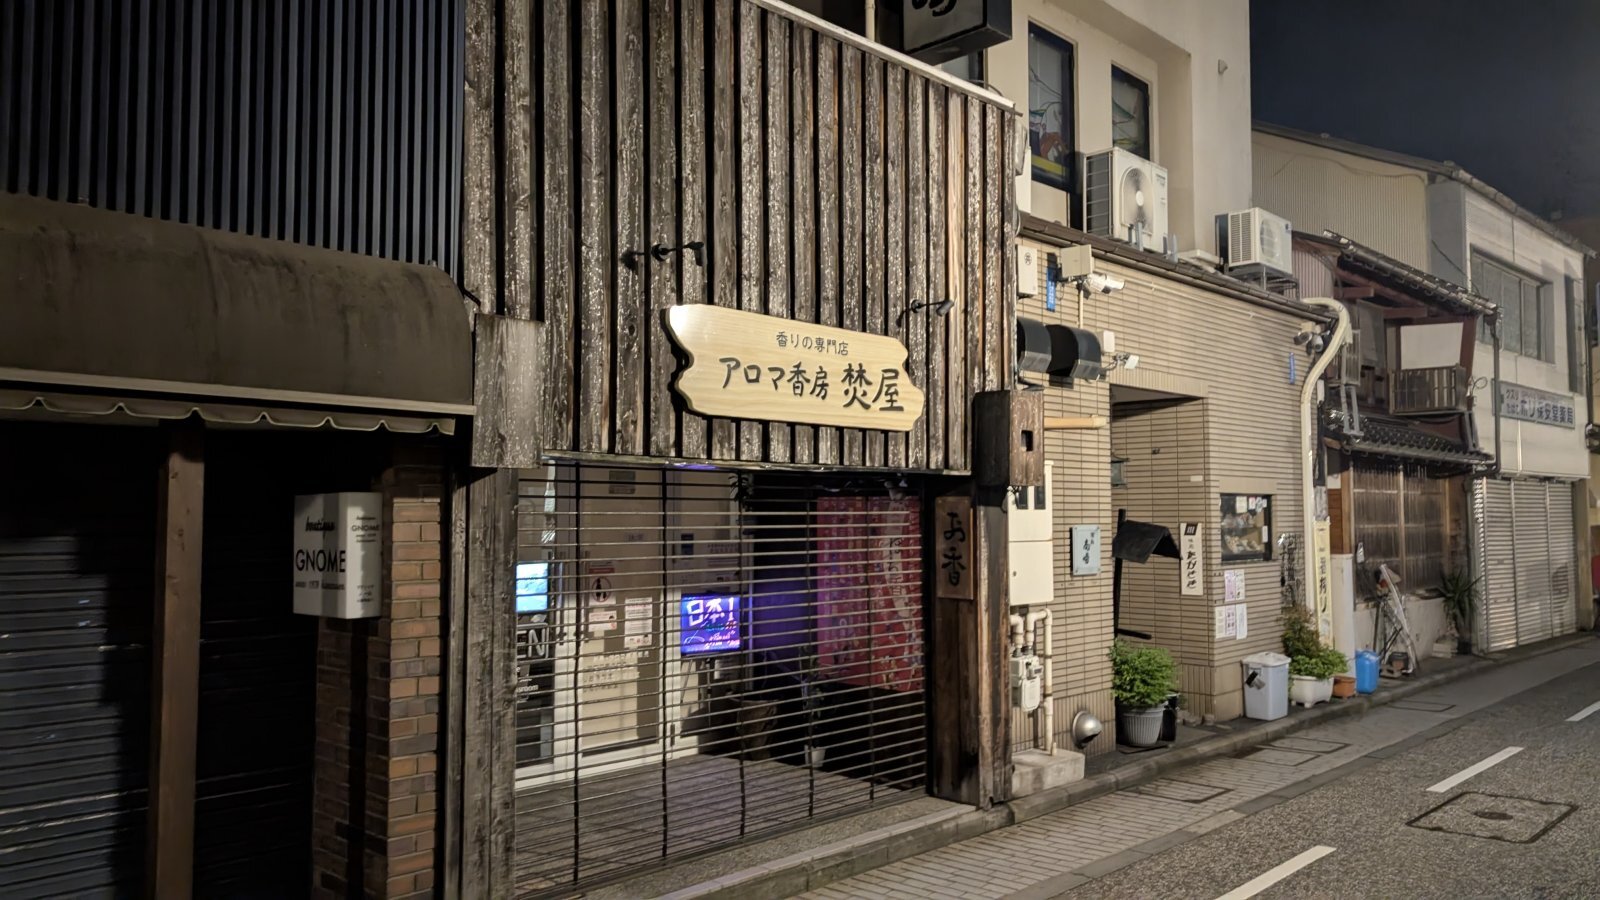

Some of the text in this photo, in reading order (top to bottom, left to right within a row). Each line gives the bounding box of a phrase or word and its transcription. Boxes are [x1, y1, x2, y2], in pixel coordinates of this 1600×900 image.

[776, 331, 849, 356] 香りの専門店
[719, 356, 904, 412] アロマ香房 焚屋
[352, 524, 380, 532] GNOME
[295, 548, 346, 573] GNOME
[941, 511, 966, 587] お香
